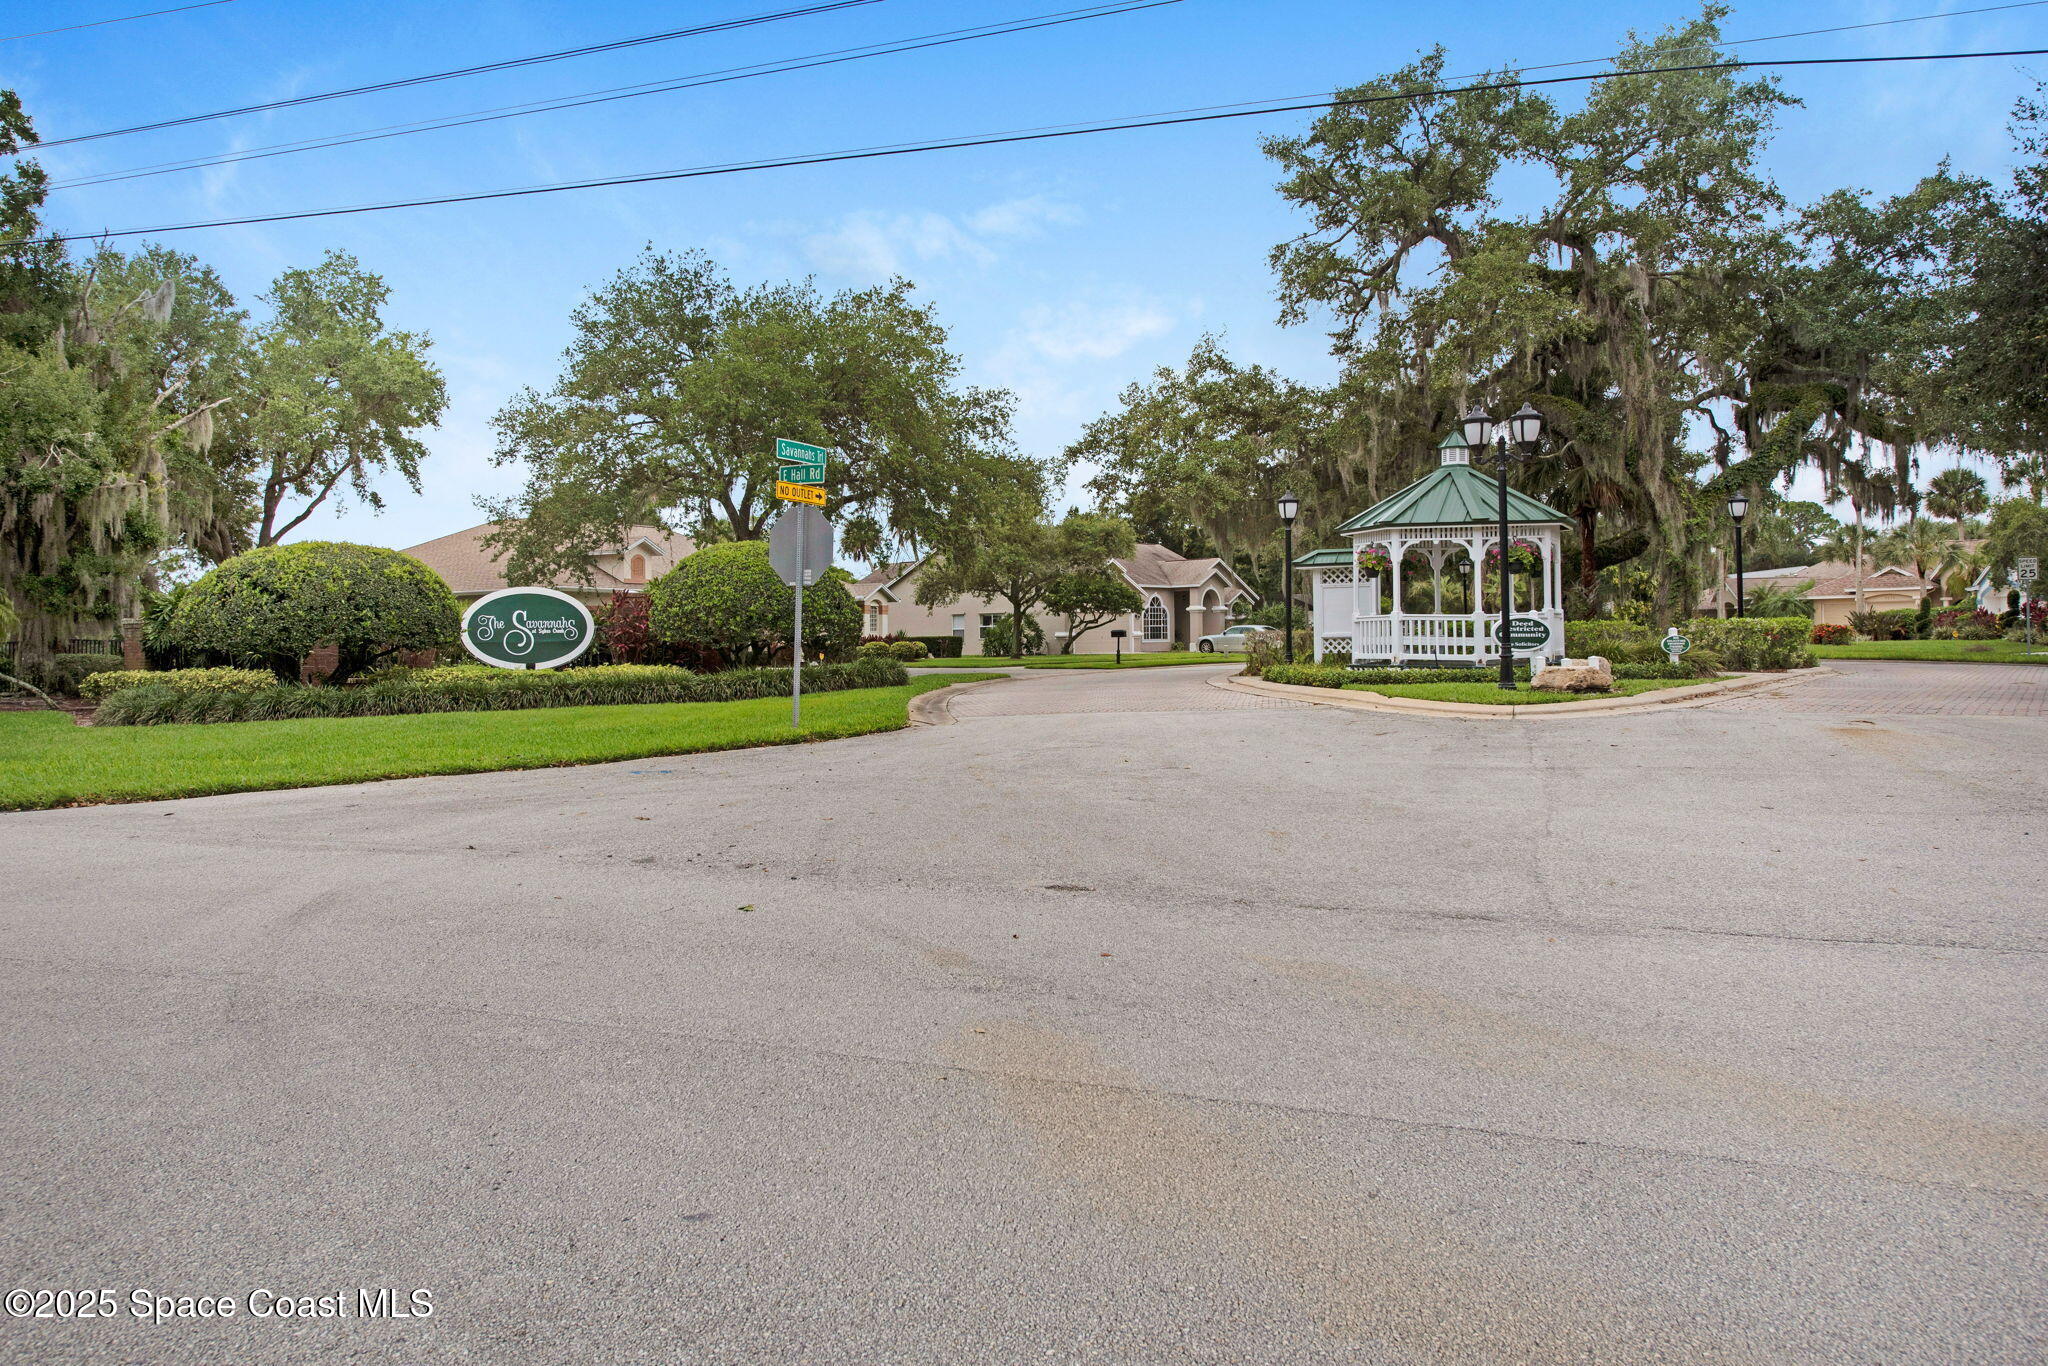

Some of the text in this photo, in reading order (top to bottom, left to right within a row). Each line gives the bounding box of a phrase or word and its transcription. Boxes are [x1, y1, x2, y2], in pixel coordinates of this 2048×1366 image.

[781, 442, 815, 461] Savannahs
[783, 467, 821, 481] E Hall Rd
[780, 485, 814, 500] NO OUTLET
[2020, 568, 2037, 578] 25
[477, 609, 579, 656] The Savannahs
